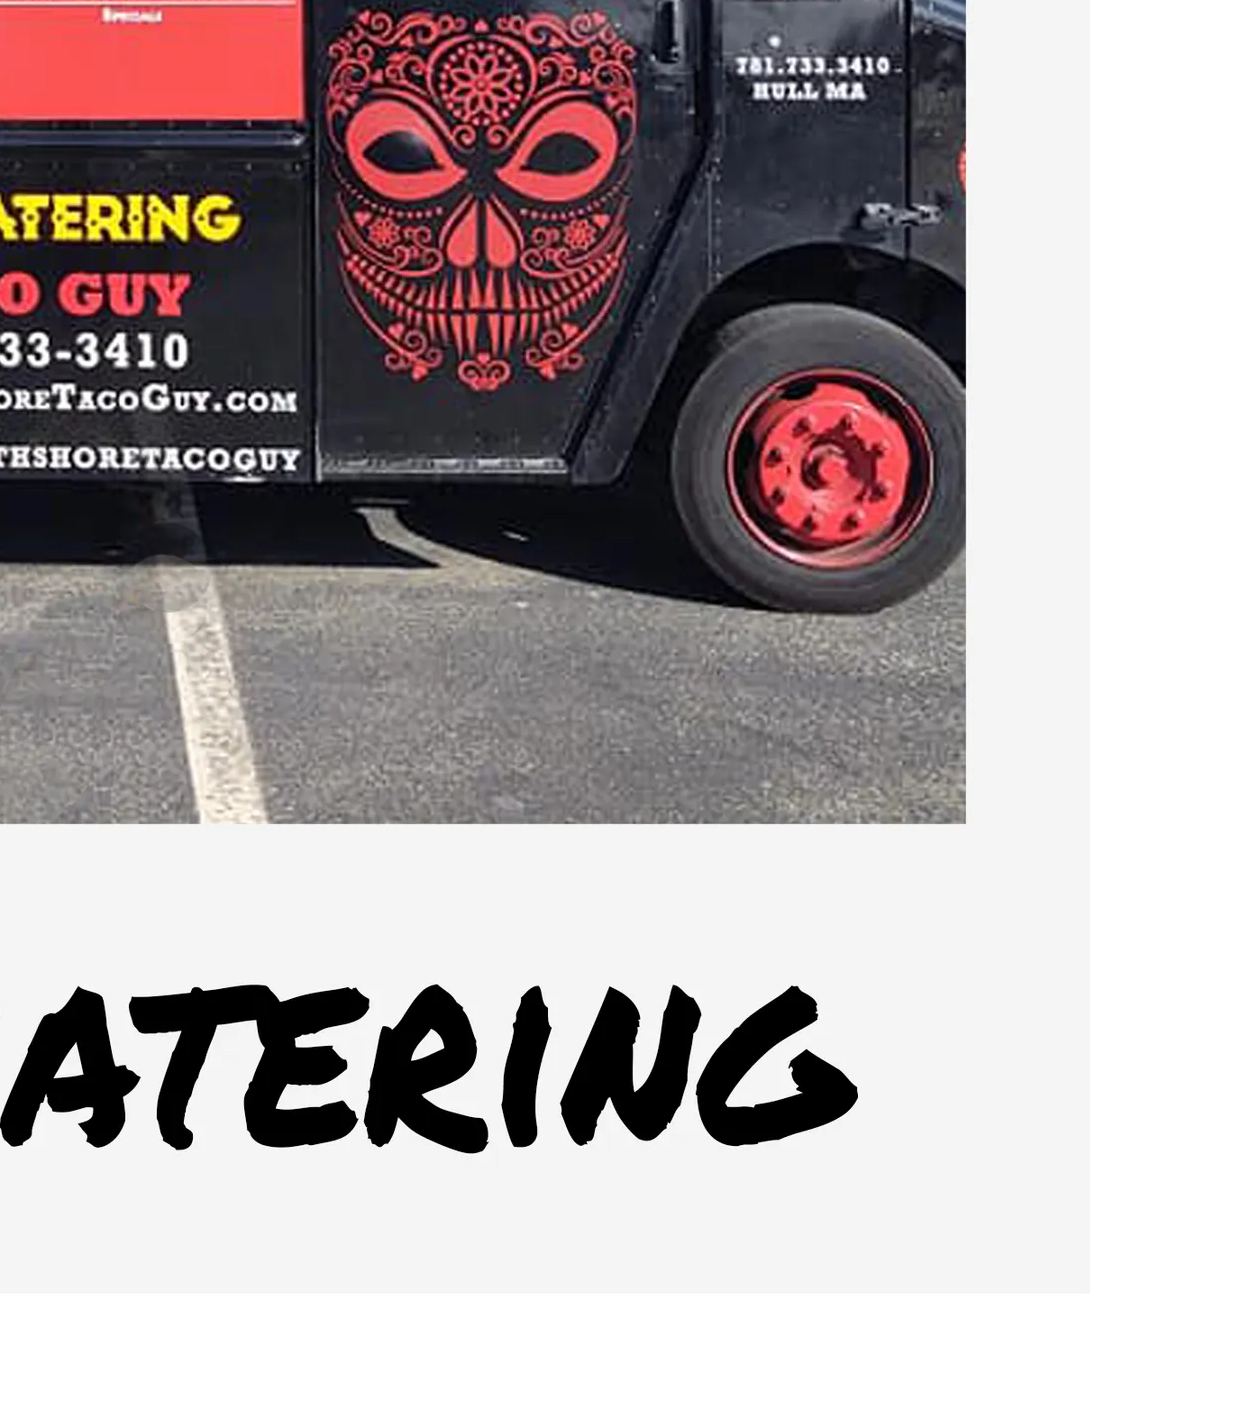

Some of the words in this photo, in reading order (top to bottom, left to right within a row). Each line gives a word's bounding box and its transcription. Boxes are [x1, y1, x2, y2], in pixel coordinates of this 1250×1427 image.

[735, 56, 890, 75] 781.733.3410
[753, 82, 819, 100] HULL
[825, 82, 867, 100] MA
[58, 273, 191, 317] GUY
